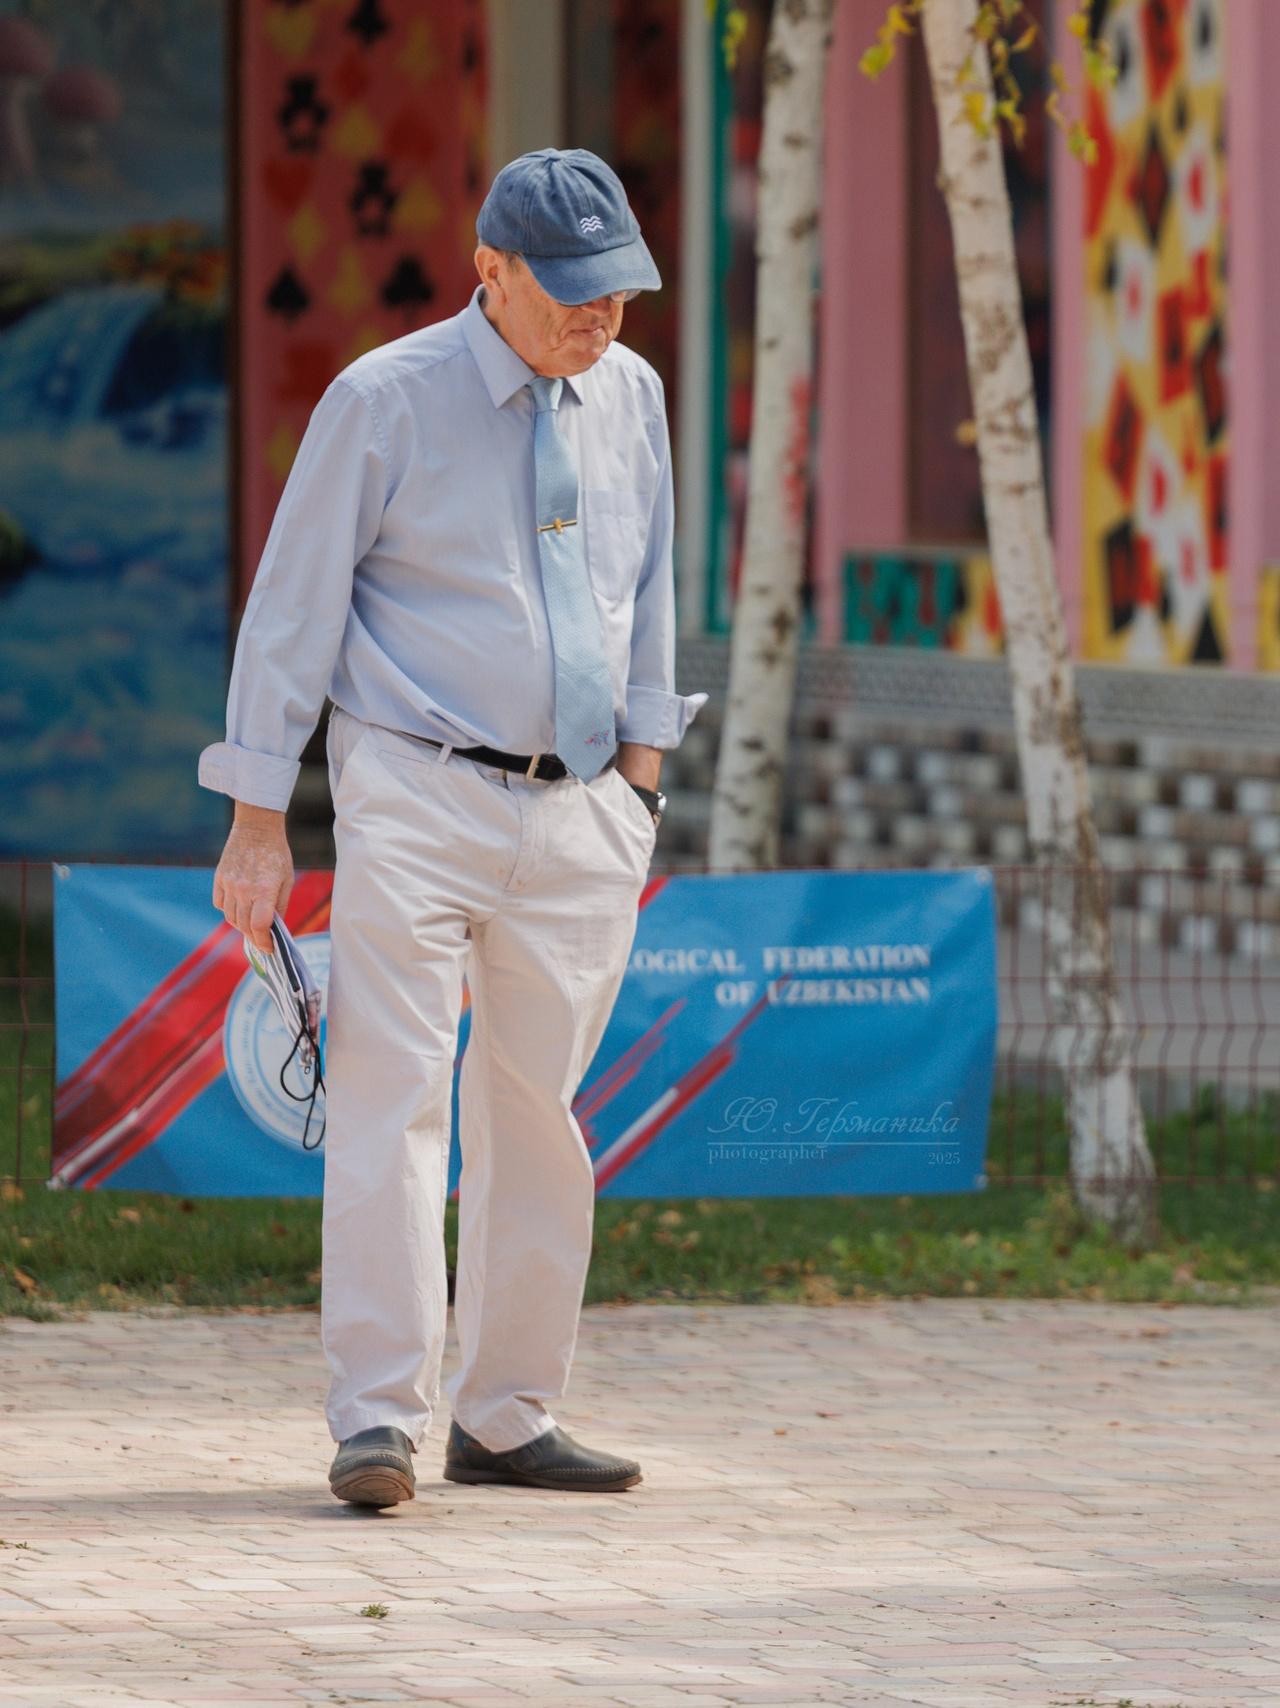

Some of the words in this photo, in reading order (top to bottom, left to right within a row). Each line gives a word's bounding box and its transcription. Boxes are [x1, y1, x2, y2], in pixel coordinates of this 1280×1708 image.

[627, 948, 746, 974] OGICAL
[763, 945, 931, 973] FEDERATION
[714, 980, 757, 1006] OF
[768, 977, 930, 1006] UZBEKISTAN
